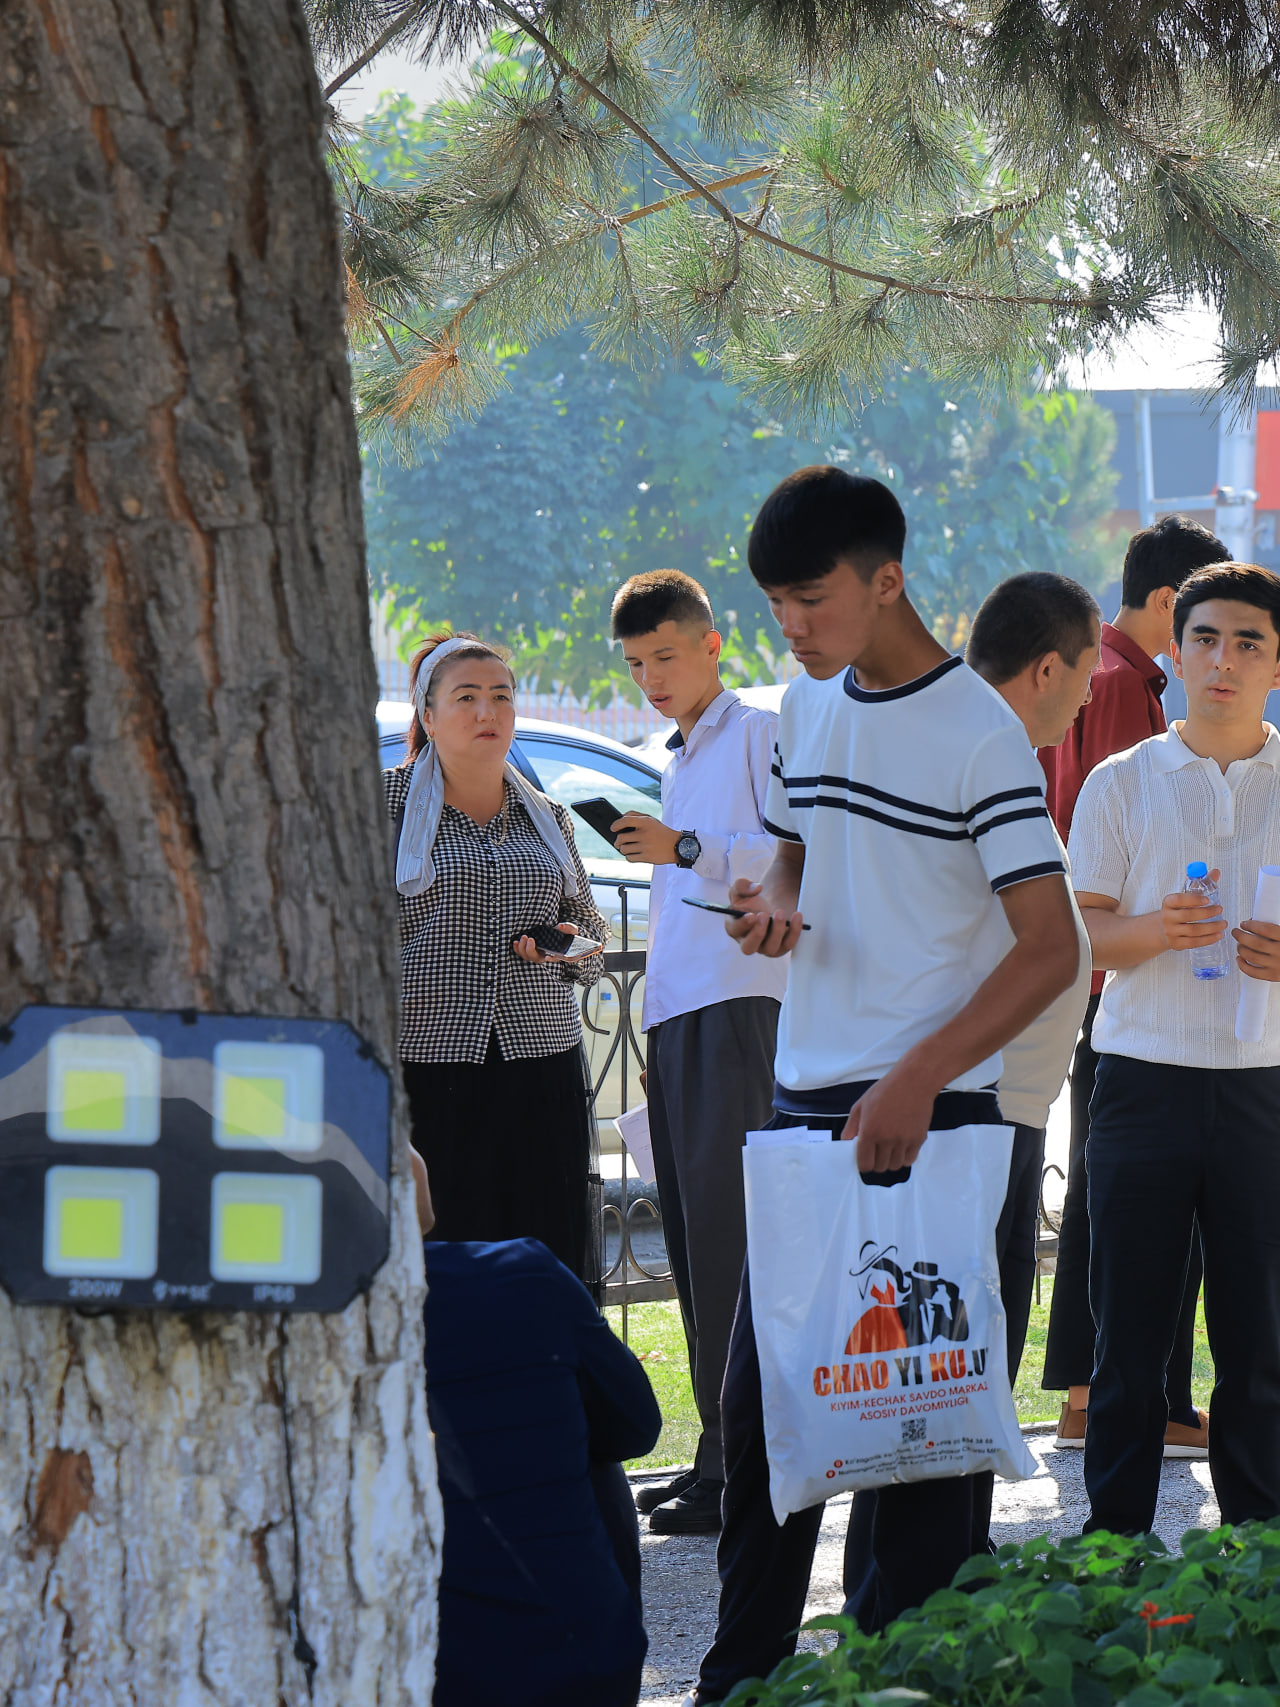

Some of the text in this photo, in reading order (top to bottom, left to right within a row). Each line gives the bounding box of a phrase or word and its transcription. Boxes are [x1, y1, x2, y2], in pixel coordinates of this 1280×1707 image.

[813, 1360, 889, 1397] CHAO
[894, 1356, 923, 1387] YI
[830, 1395, 907, 1412] KIYIM-KECHAK
[909, 1389, 946, 1403] SAVDO
[859, 1407, 897, 1421] ASOSIY
